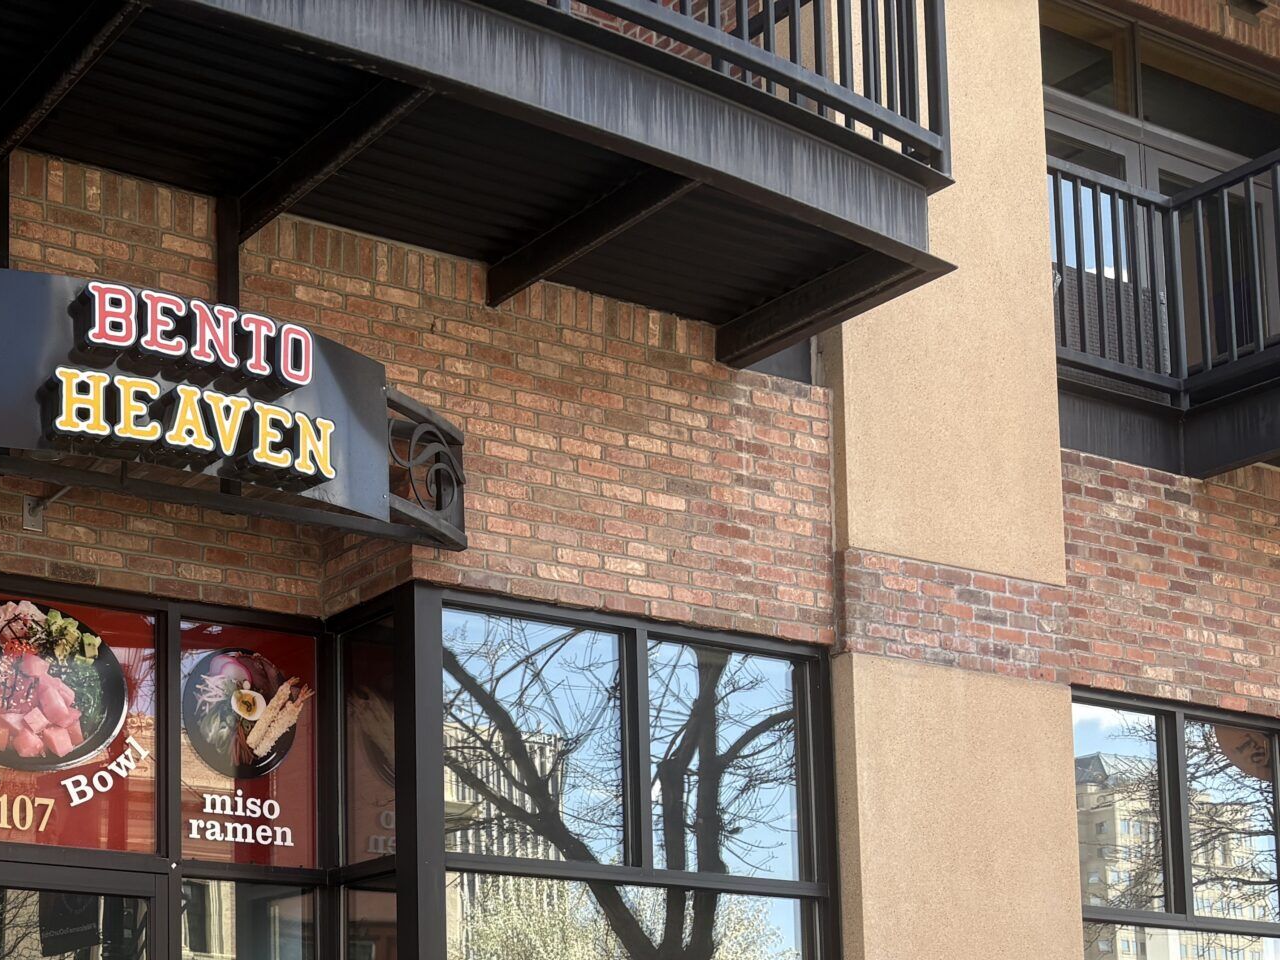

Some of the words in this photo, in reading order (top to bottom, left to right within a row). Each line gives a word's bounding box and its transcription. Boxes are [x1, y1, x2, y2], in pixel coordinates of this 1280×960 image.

[86, 279, 315, 387] BENTO
[53, 365, 336, 480] HEAVEN
[61, 736, 150, 807] Bowl
[203, 789, 280, 820] miso
[189, 819, 294, 846] ramen
